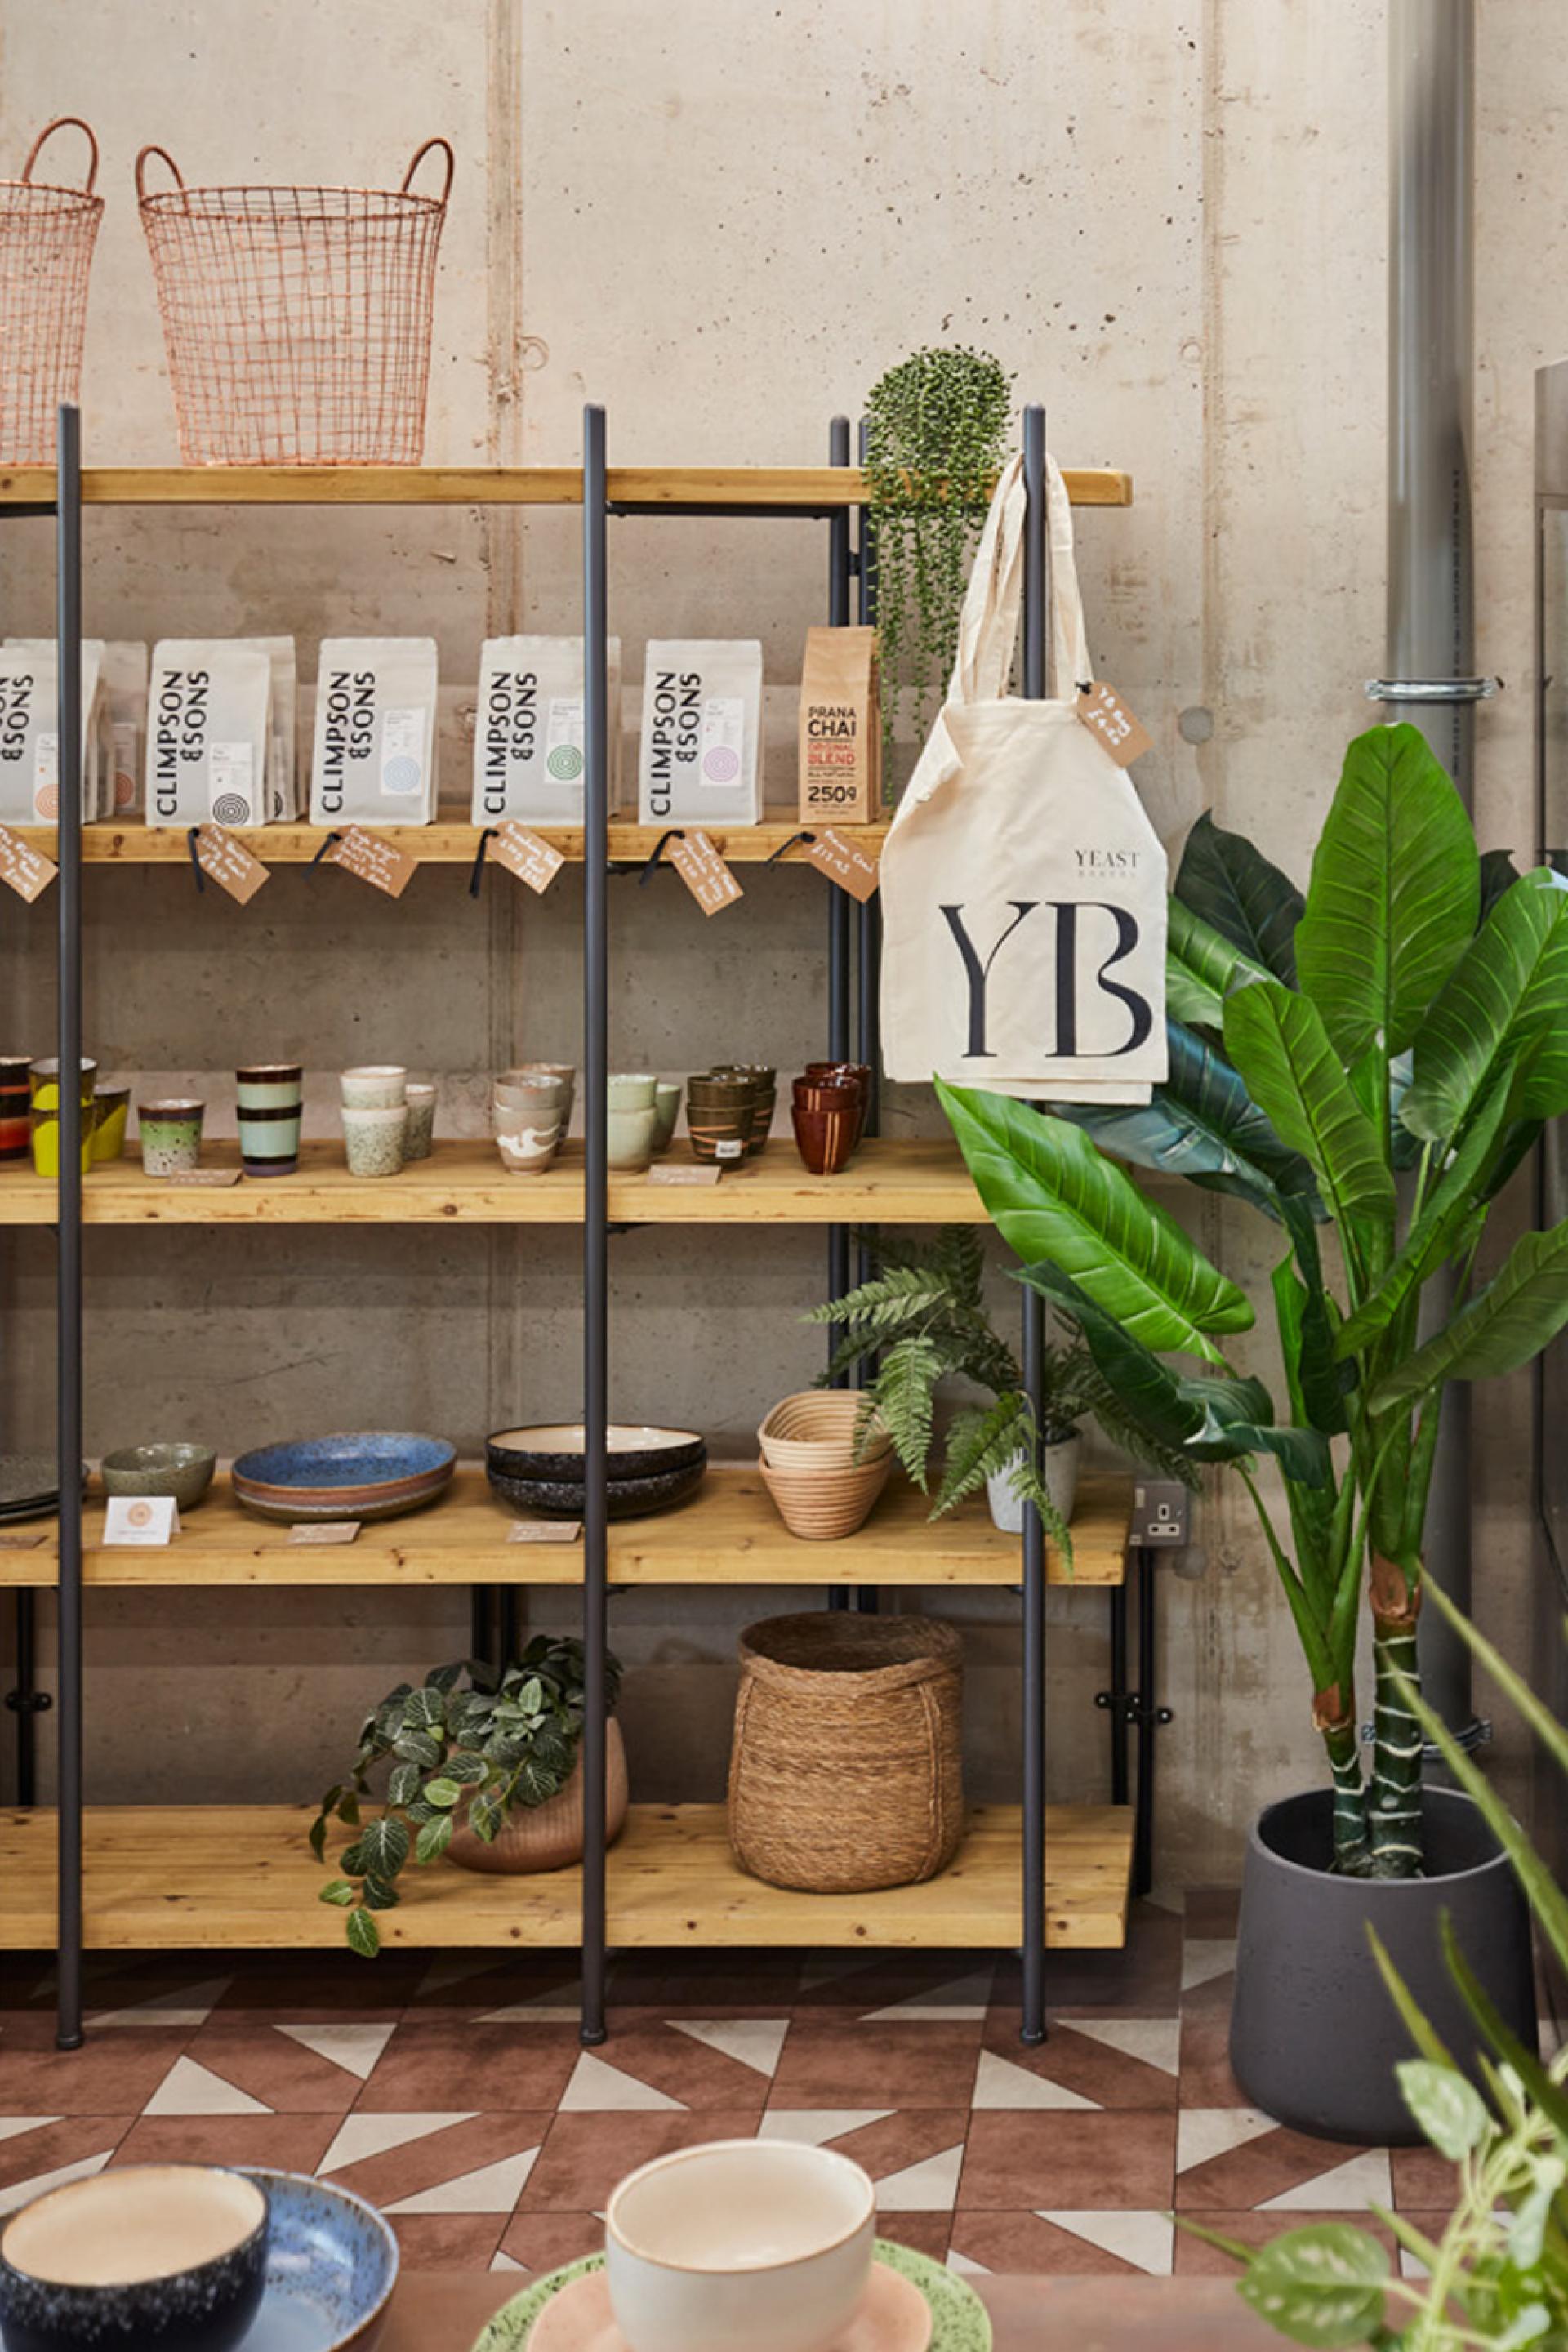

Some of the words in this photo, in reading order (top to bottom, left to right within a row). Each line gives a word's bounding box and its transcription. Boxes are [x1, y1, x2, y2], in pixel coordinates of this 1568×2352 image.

[157, 671, 184, 816] CLIMPSON
[322, 671, 350, 813] CLIMPSON
[484, 672, 512, 813] CLIMPSON
[650, 672, 676, 816] CLIMPSON
[808, 706, 857, 717] PRANA
[808, 719, 857, 736] CHAI
[808, 754, 855, 764] BLEND
[1074, 849, 1141, 867] YEAST
[937, 900, 1153, 1059] YB
